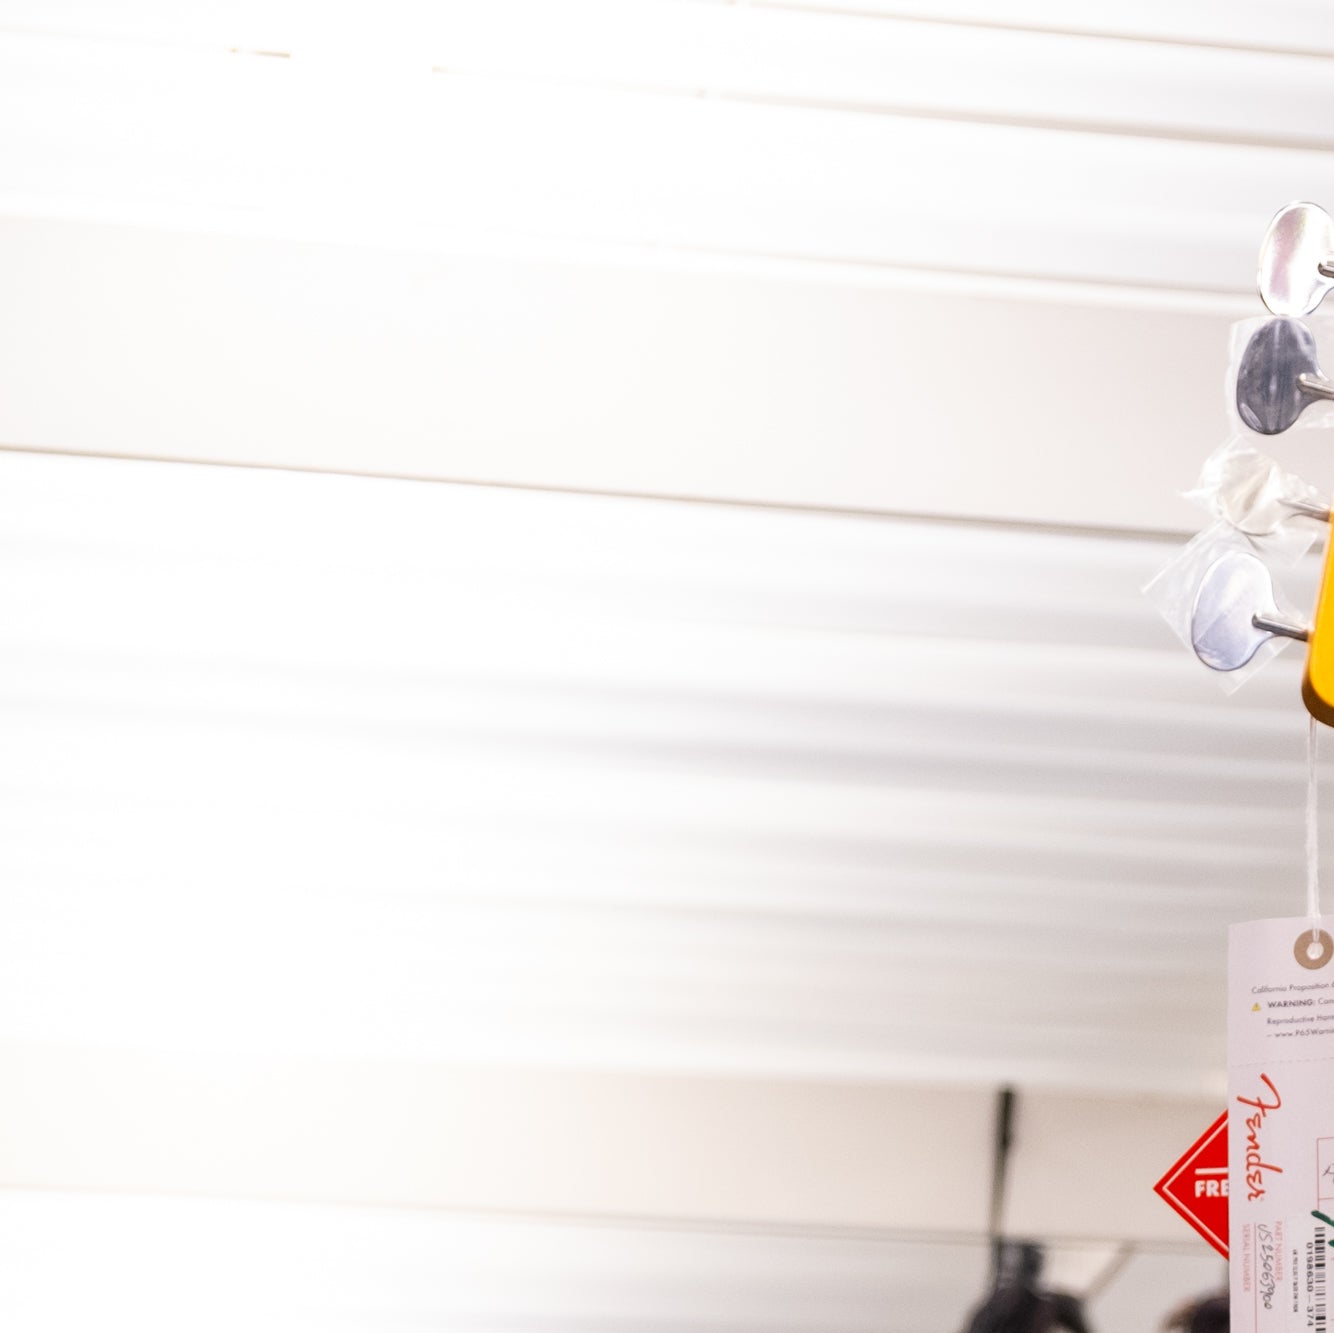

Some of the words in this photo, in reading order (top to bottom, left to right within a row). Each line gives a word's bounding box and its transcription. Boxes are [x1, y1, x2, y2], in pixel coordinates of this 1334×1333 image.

[1251, 984, 1288, 994] California
[1289, 983, 1329, 992] Proposition
[1267, 1016, 1315, 1026] Reproductive
[1236, 1072, 1283, 1202] Fender
[1242, 1253, 1251, 1293] NUMBER
[1275, 1243, 1284, 1282] NUMBER
